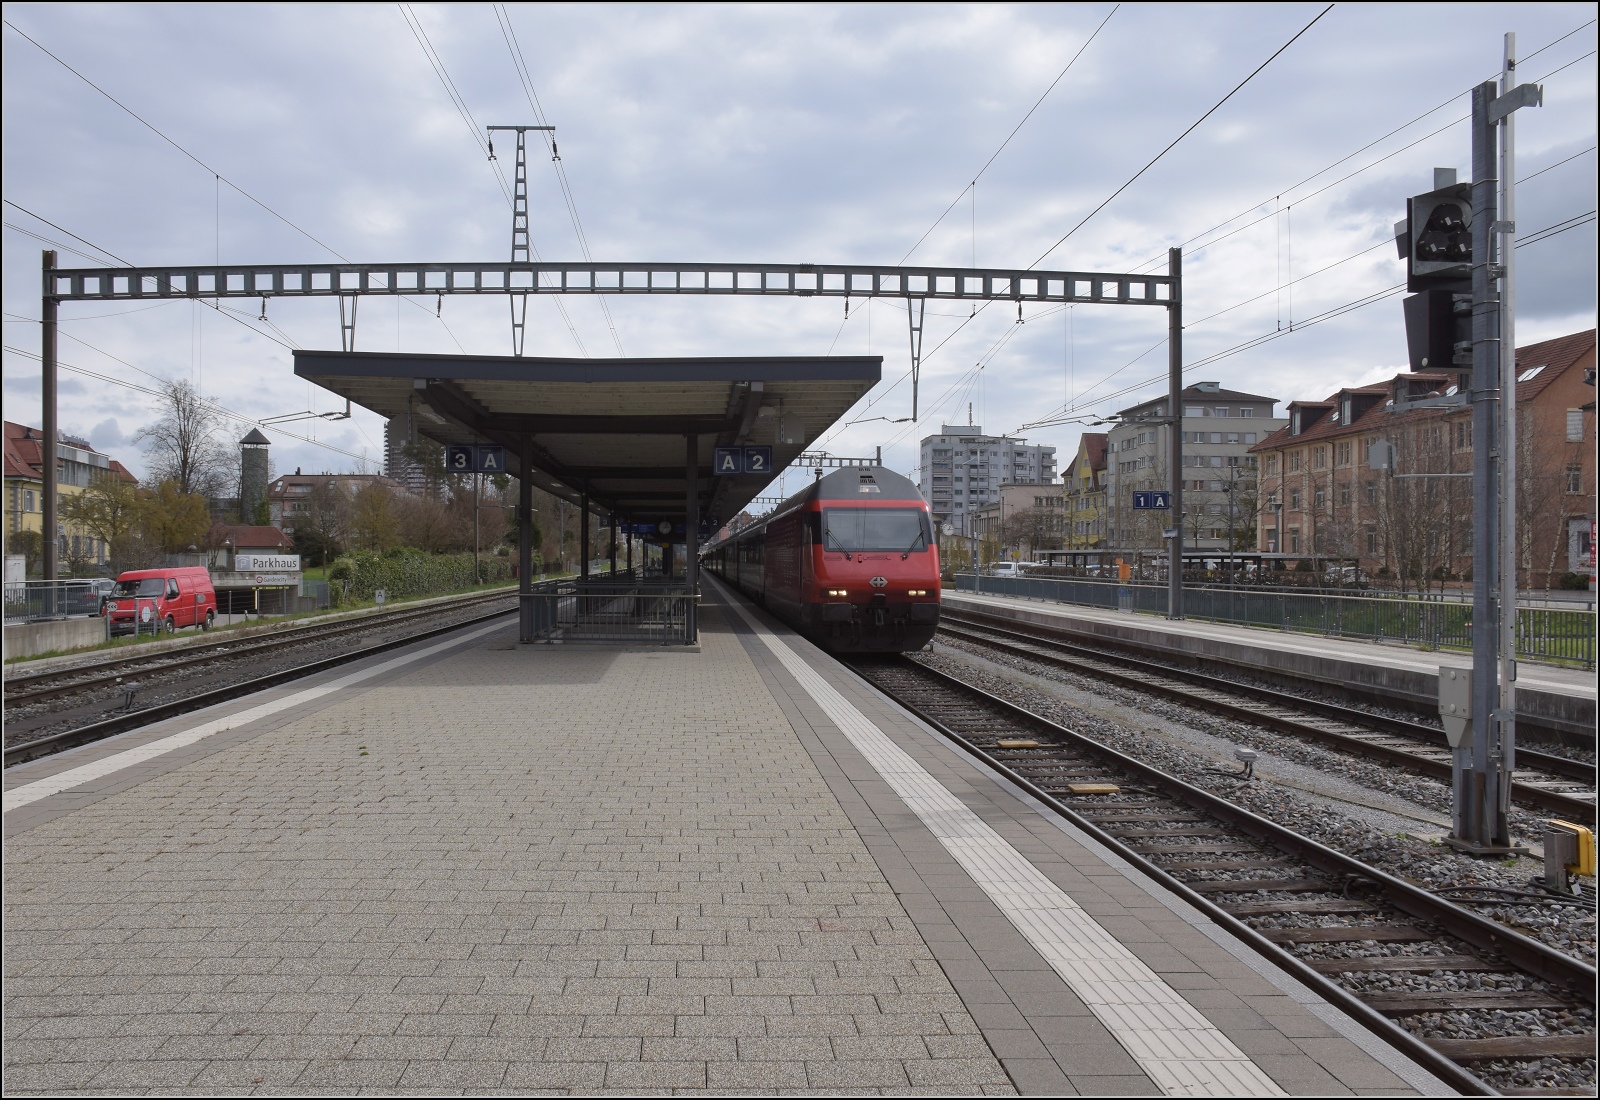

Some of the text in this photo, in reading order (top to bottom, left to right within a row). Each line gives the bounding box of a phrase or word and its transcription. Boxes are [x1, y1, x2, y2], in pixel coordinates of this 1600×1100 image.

[455, 453, 497, 468] 3 A
[722, 455, 764, 470] A 2
[1139, 496, 1165, 507] 1 A
[253, 557, 297, 568] Parkhaus
